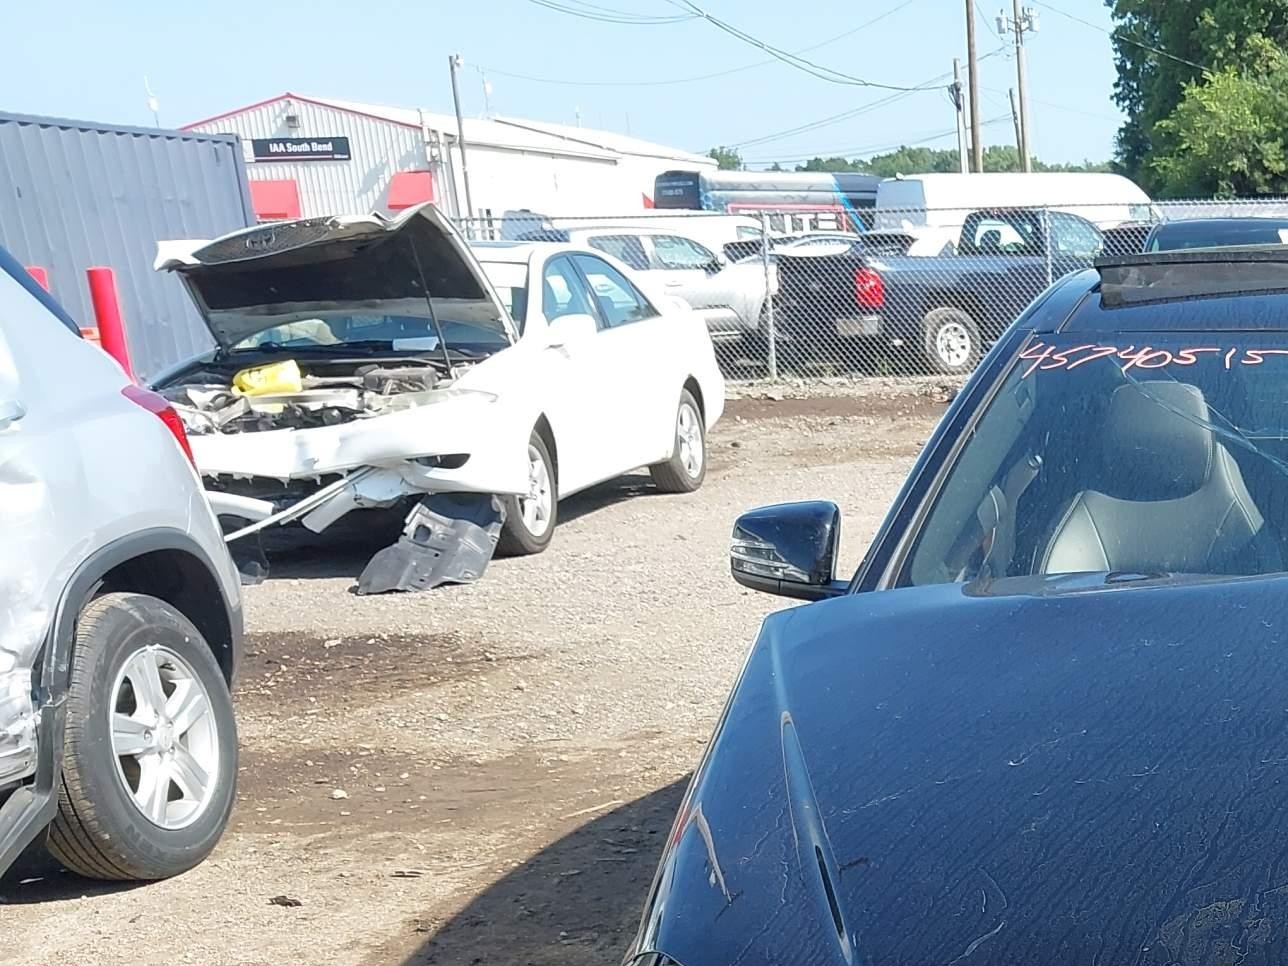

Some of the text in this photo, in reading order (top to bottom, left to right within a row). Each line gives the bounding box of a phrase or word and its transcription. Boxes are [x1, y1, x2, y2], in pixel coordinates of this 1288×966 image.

[269, 141, 333, 153] IAA South Bend
